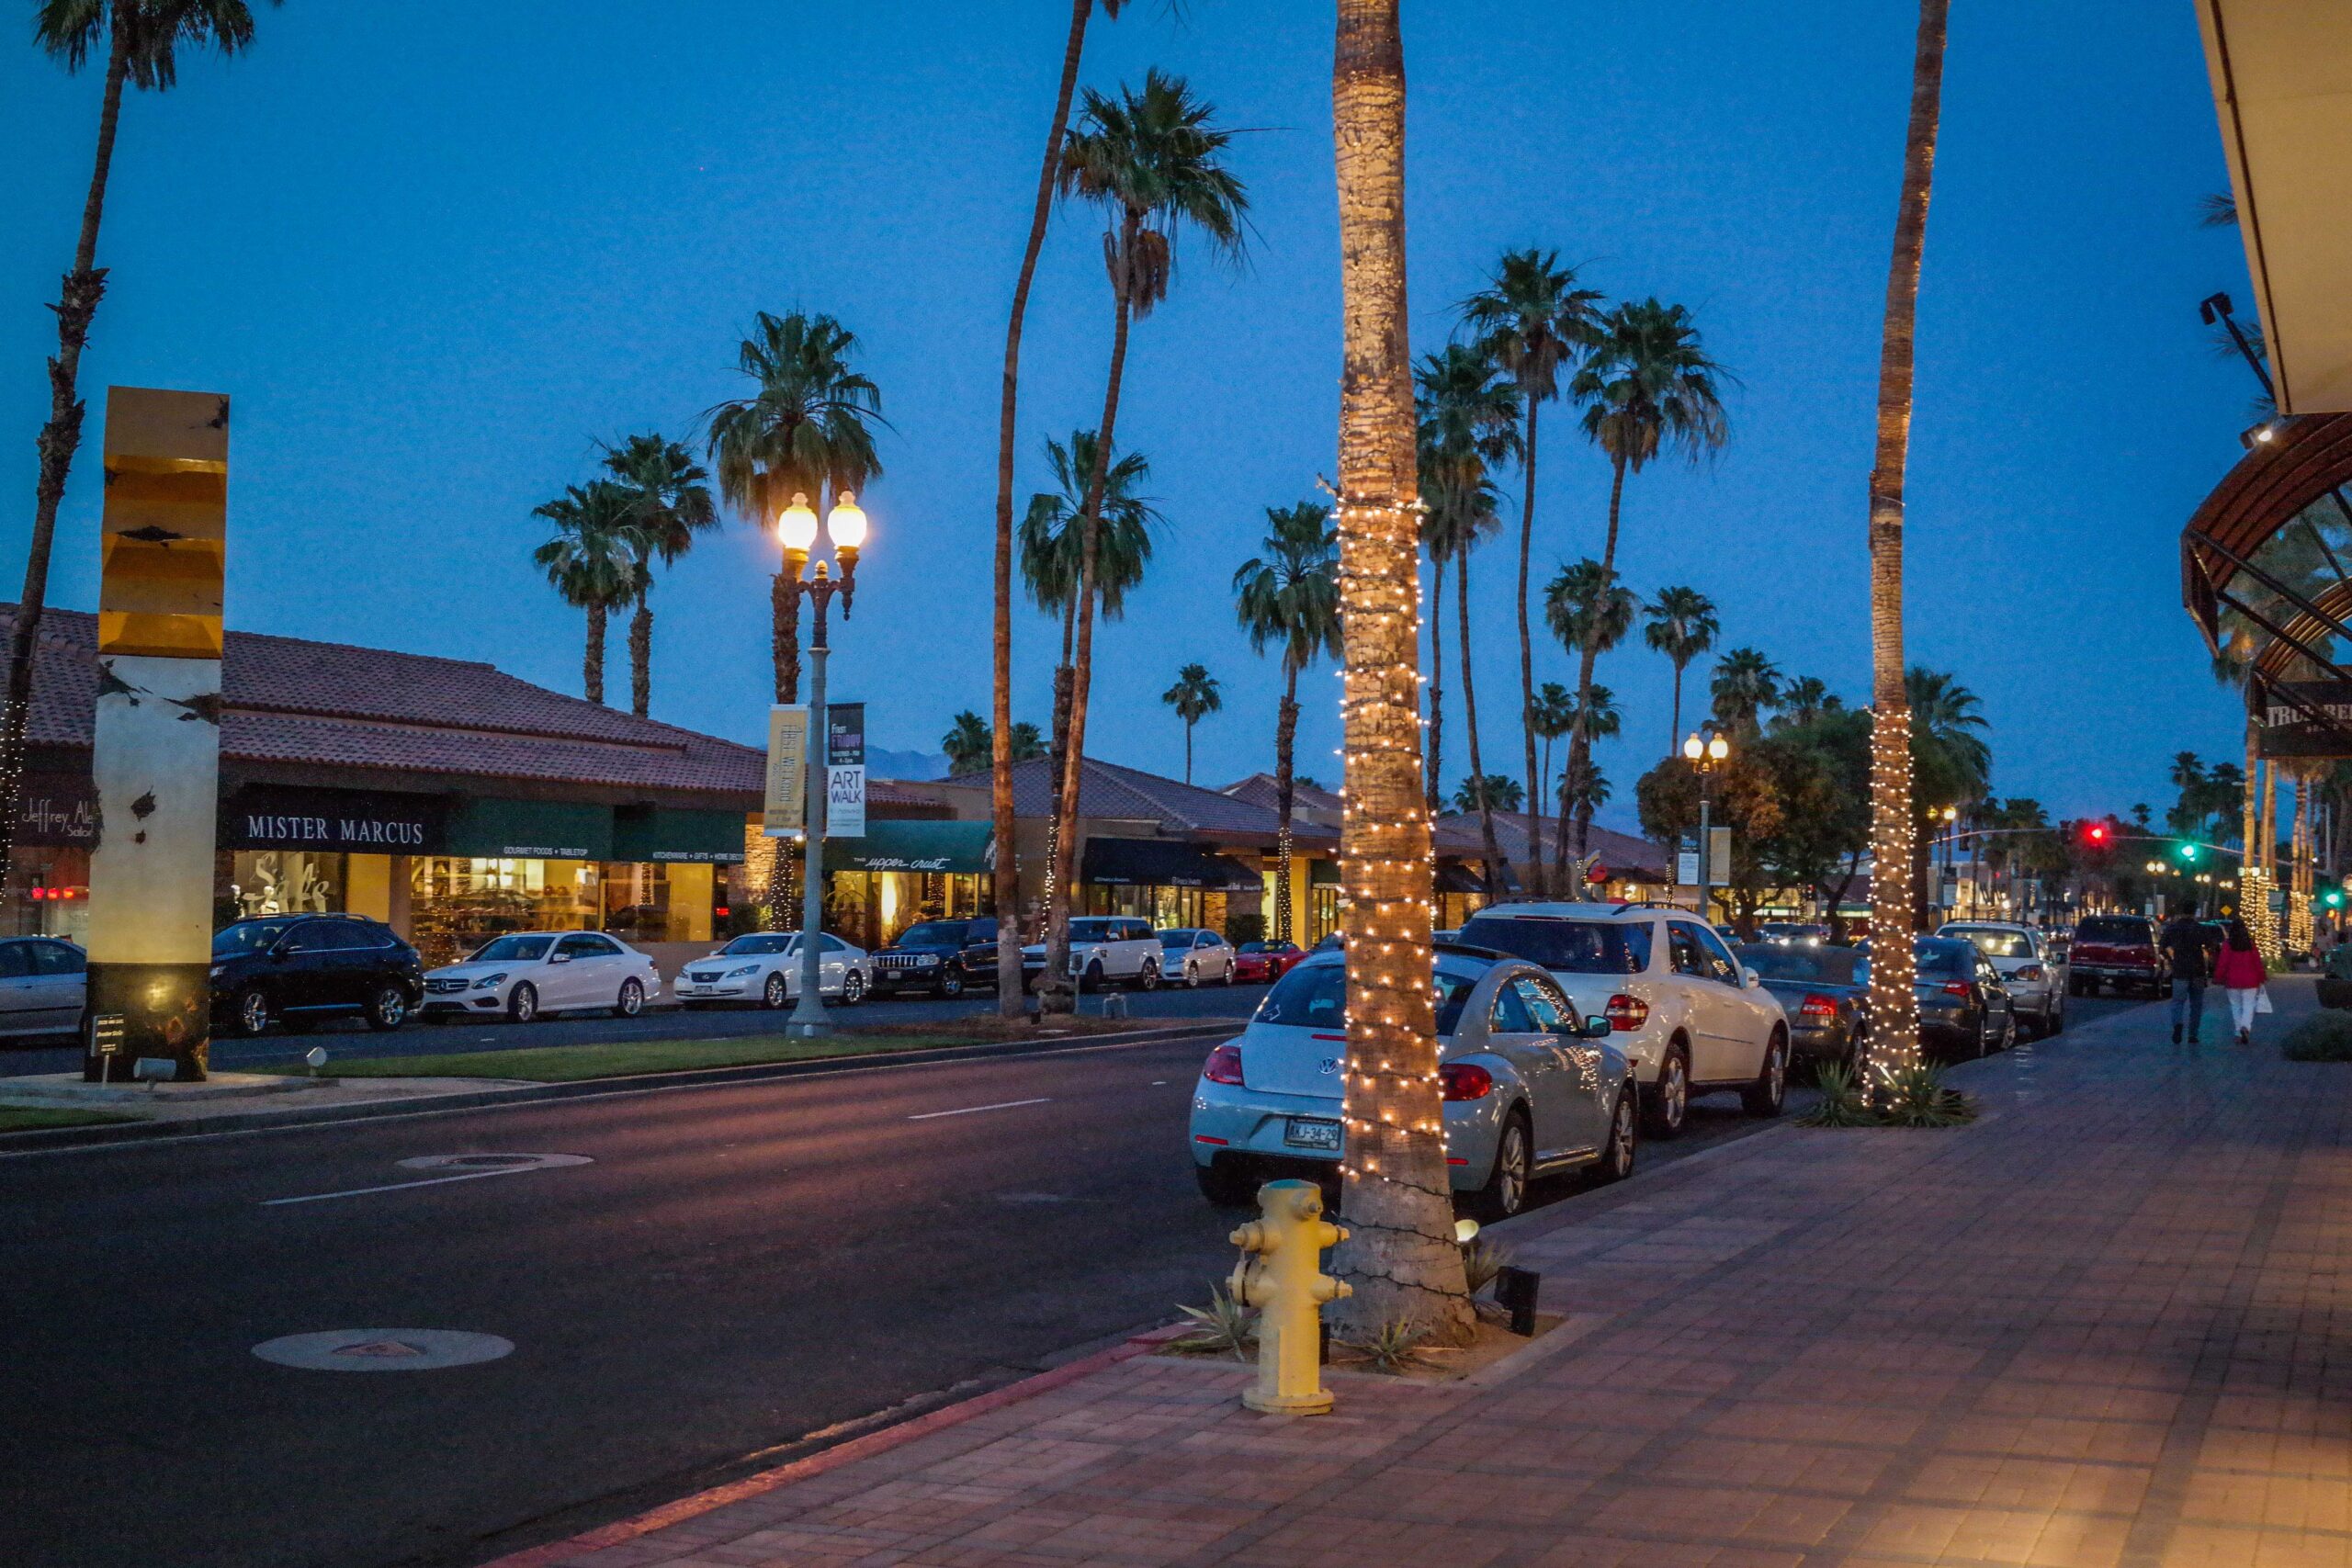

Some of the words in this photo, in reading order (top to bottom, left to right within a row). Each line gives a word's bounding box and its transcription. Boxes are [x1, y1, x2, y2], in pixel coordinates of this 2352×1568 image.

[830, 770, 862, 789] ART
[831, 789, 862, 804] WALK
[21, 797, 70, 833] Jeffrey
[74, 800, 95, 824] Ale
[248, 815, 329, 840] MISTER
[339, 818, 424, 844] MARCUS
[503, 846, 532, 855] GOURMET
[533, 847, 553, 855] FOODS
[560, 848, 588, 856] TABLETOP
[865, 857, 910, 871] upper
[910, 857, 951, 870] crust
